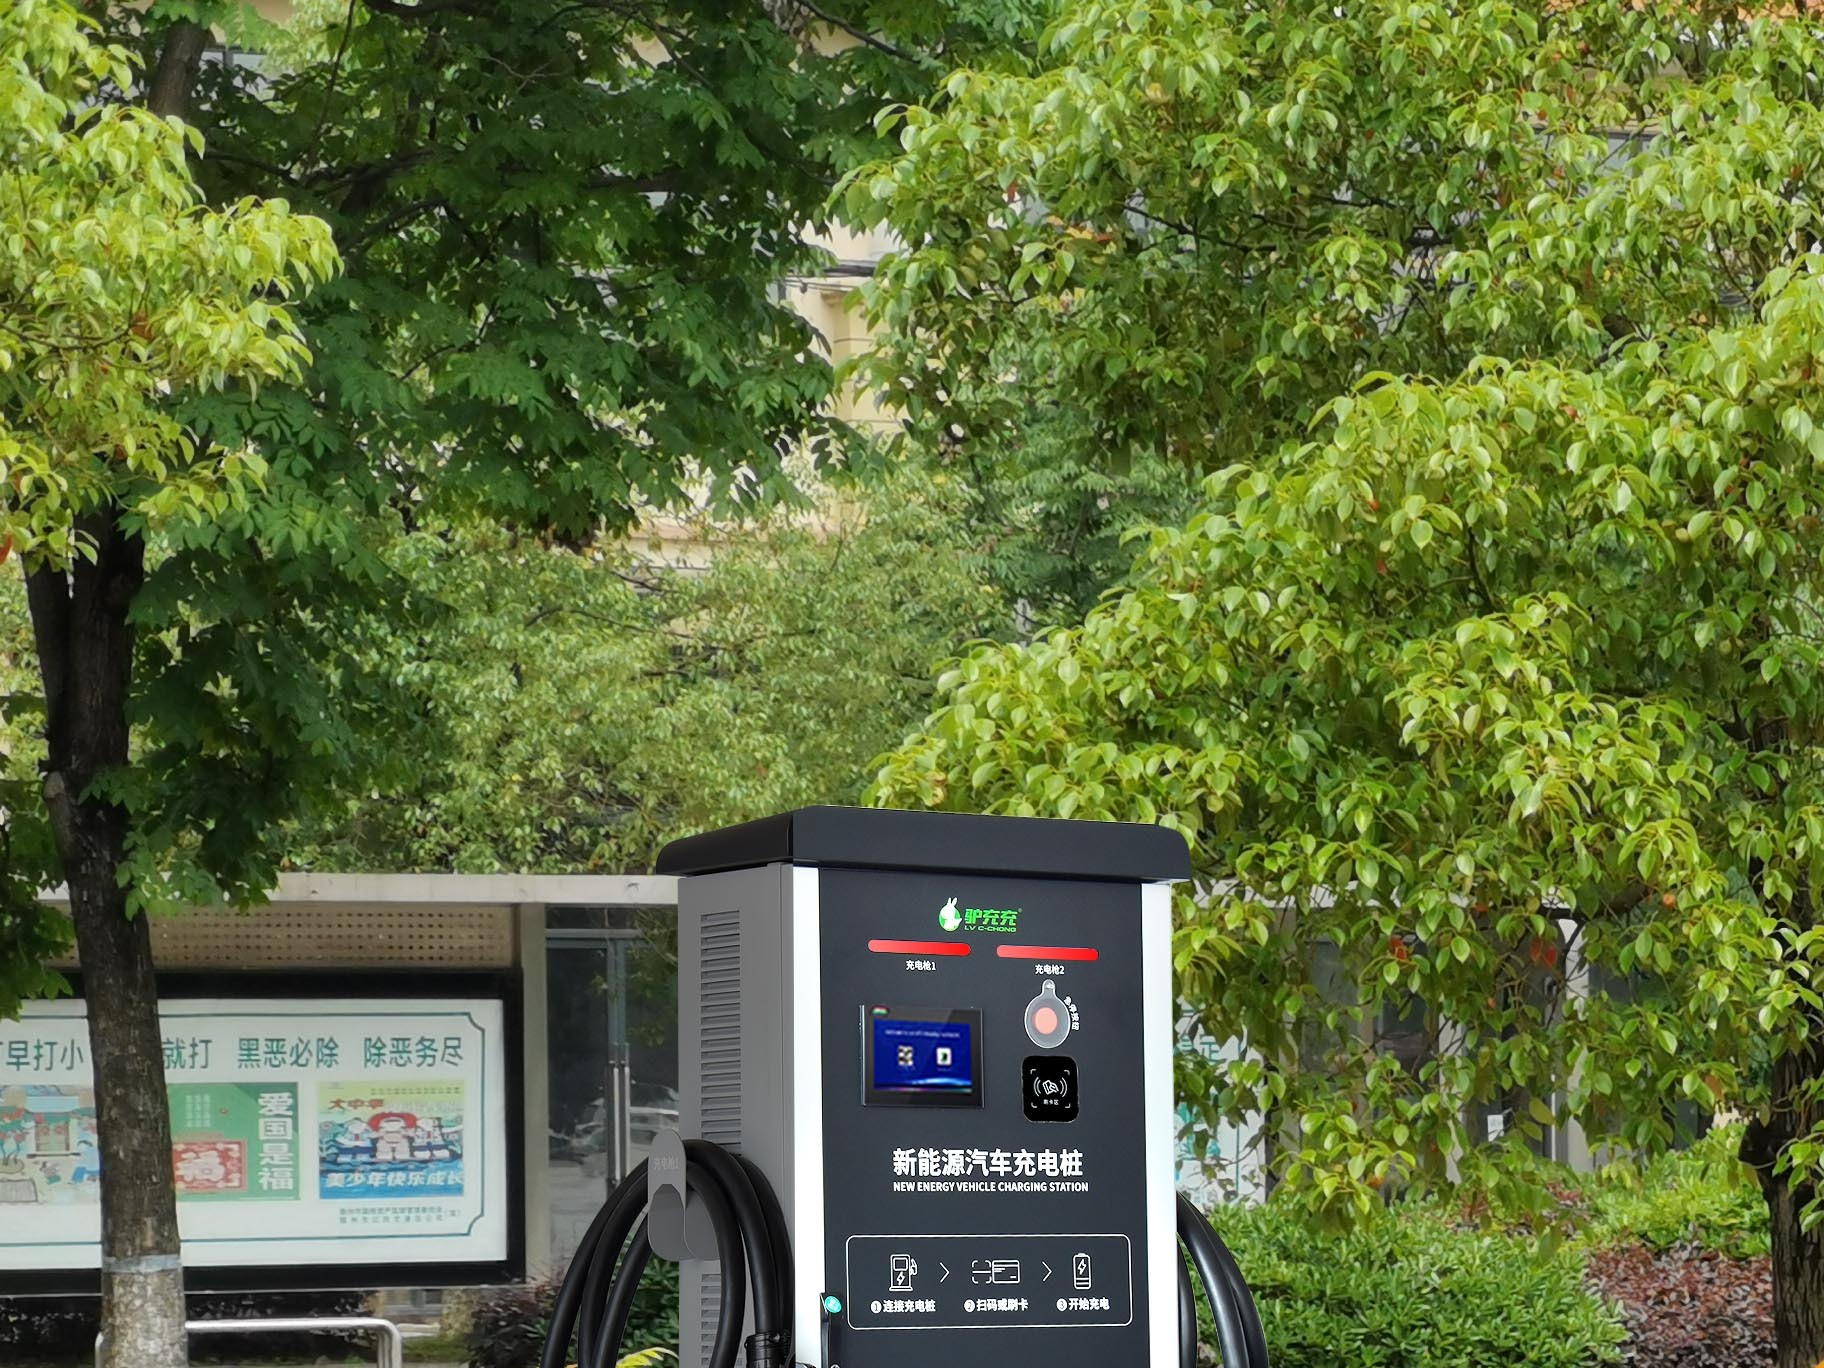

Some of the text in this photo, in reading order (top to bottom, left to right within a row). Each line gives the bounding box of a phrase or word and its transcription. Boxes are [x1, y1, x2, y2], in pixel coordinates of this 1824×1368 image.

[964, 908, 1017, 926] 驴充充
[905, 959, 937, 971] 充电枪1
[1034, 963, 1065, 975] 充电枪2
[0, 1038, 84, 1071] 早打小
[237, 1036, 340, 1069] 黑恶必除
[364, 1036, 464, 1068] 除恶务尽
[258, 1091, 293, 1191] 爱国是福
[893, 1148, 1083, 1177] 新能源汽车充电桩
[893, 1181, 1089, 1192] NEW ENERGY VEHICLE CHARGING STATION
